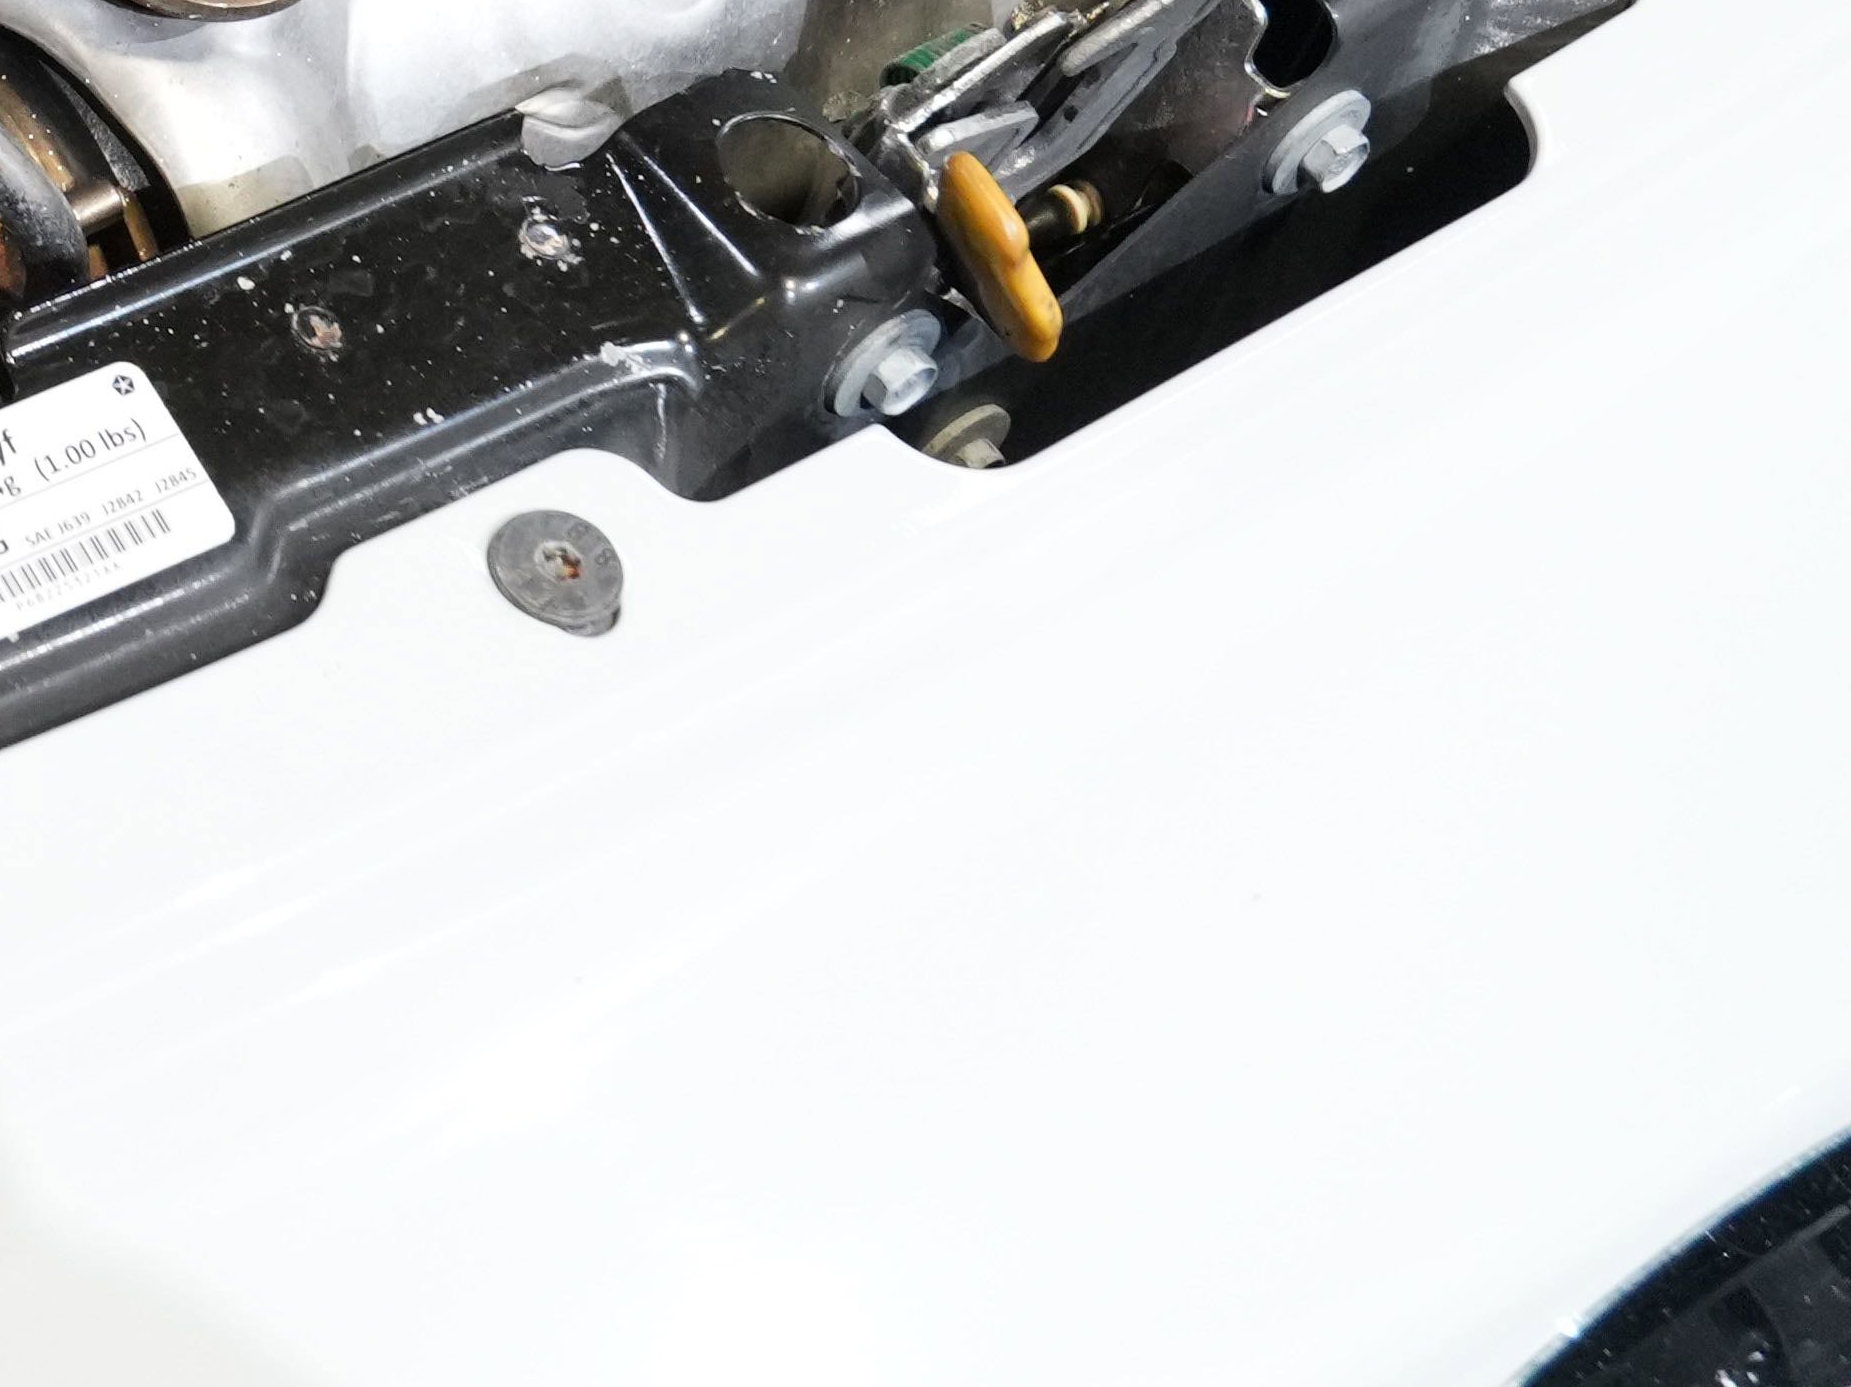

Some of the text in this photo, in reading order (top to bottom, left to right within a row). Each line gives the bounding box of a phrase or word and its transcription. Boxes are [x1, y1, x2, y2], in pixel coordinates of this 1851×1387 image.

[34, 438, 97, 484] (1.00
[100, 417, 147, 457] lbs)
[101, 490, 143, 516] J2842
